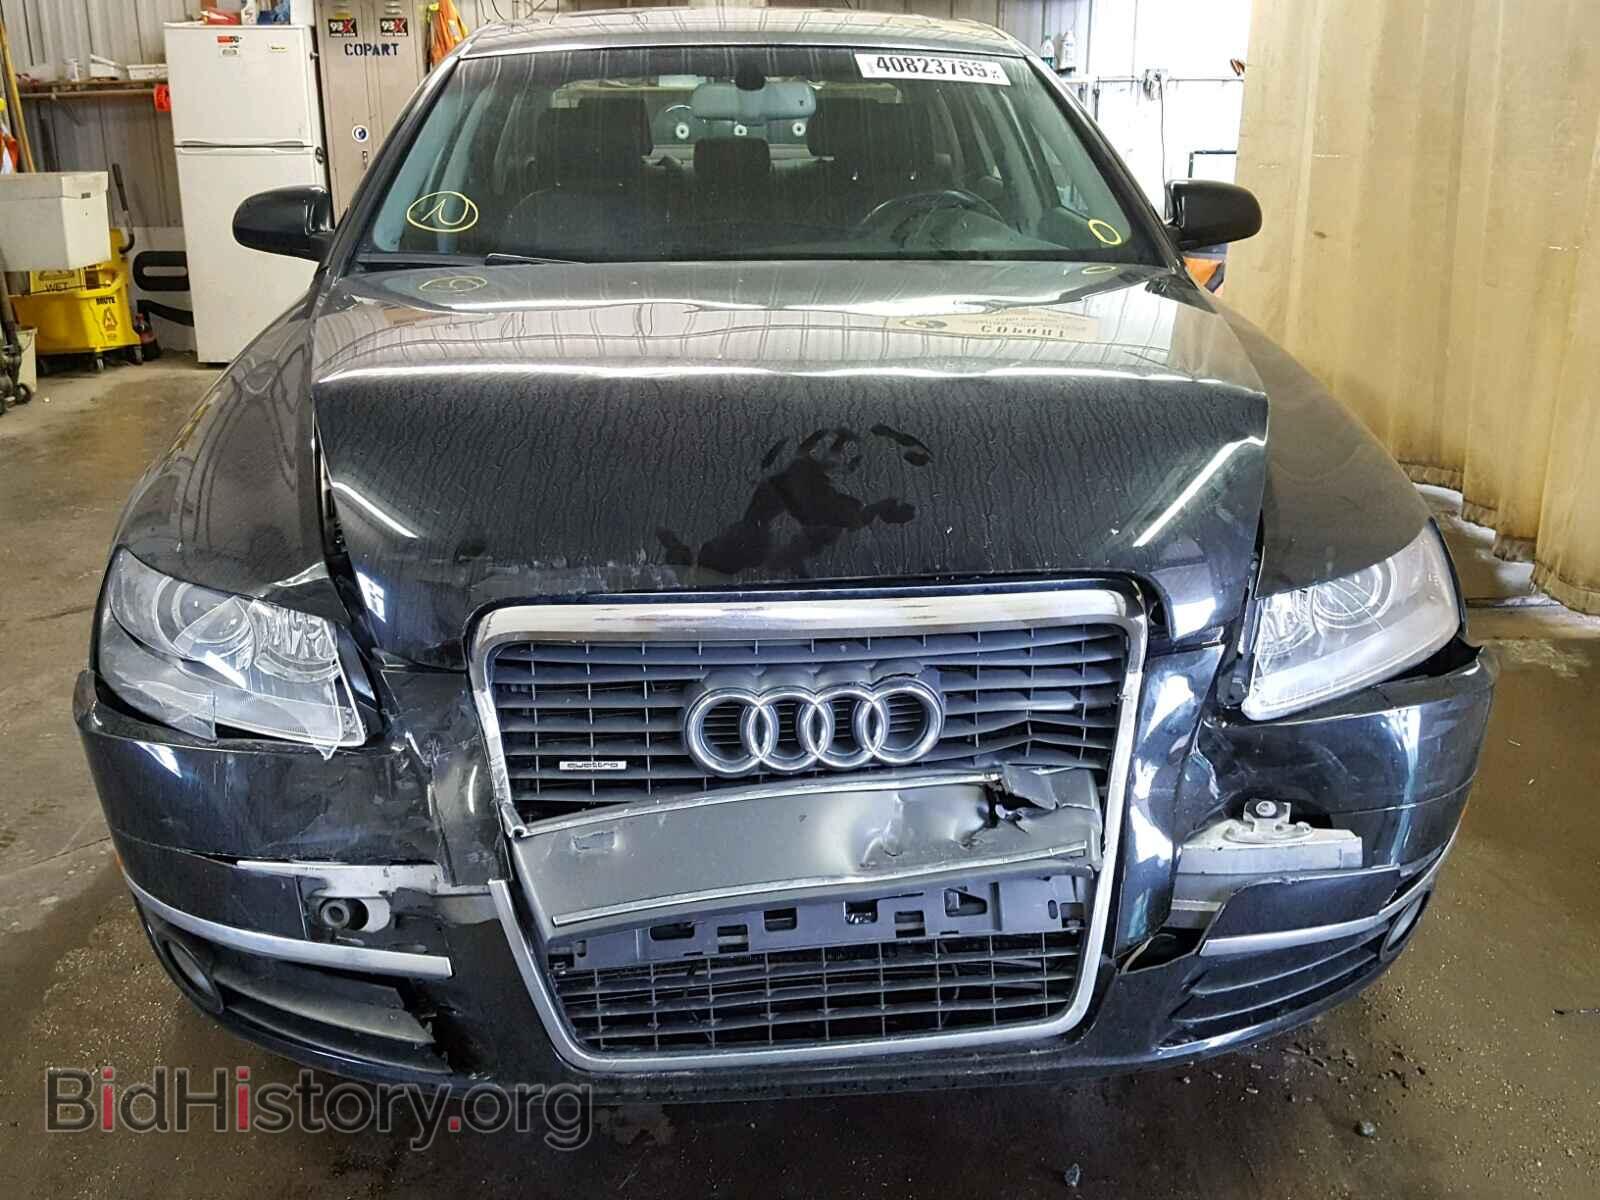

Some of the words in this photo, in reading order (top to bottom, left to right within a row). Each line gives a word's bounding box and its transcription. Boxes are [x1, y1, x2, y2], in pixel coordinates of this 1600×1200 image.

[344, 43, 399, 56] COPART
[876, 55, 988, 78] 40823769
[95, 295, 117, 305] BRUTE
